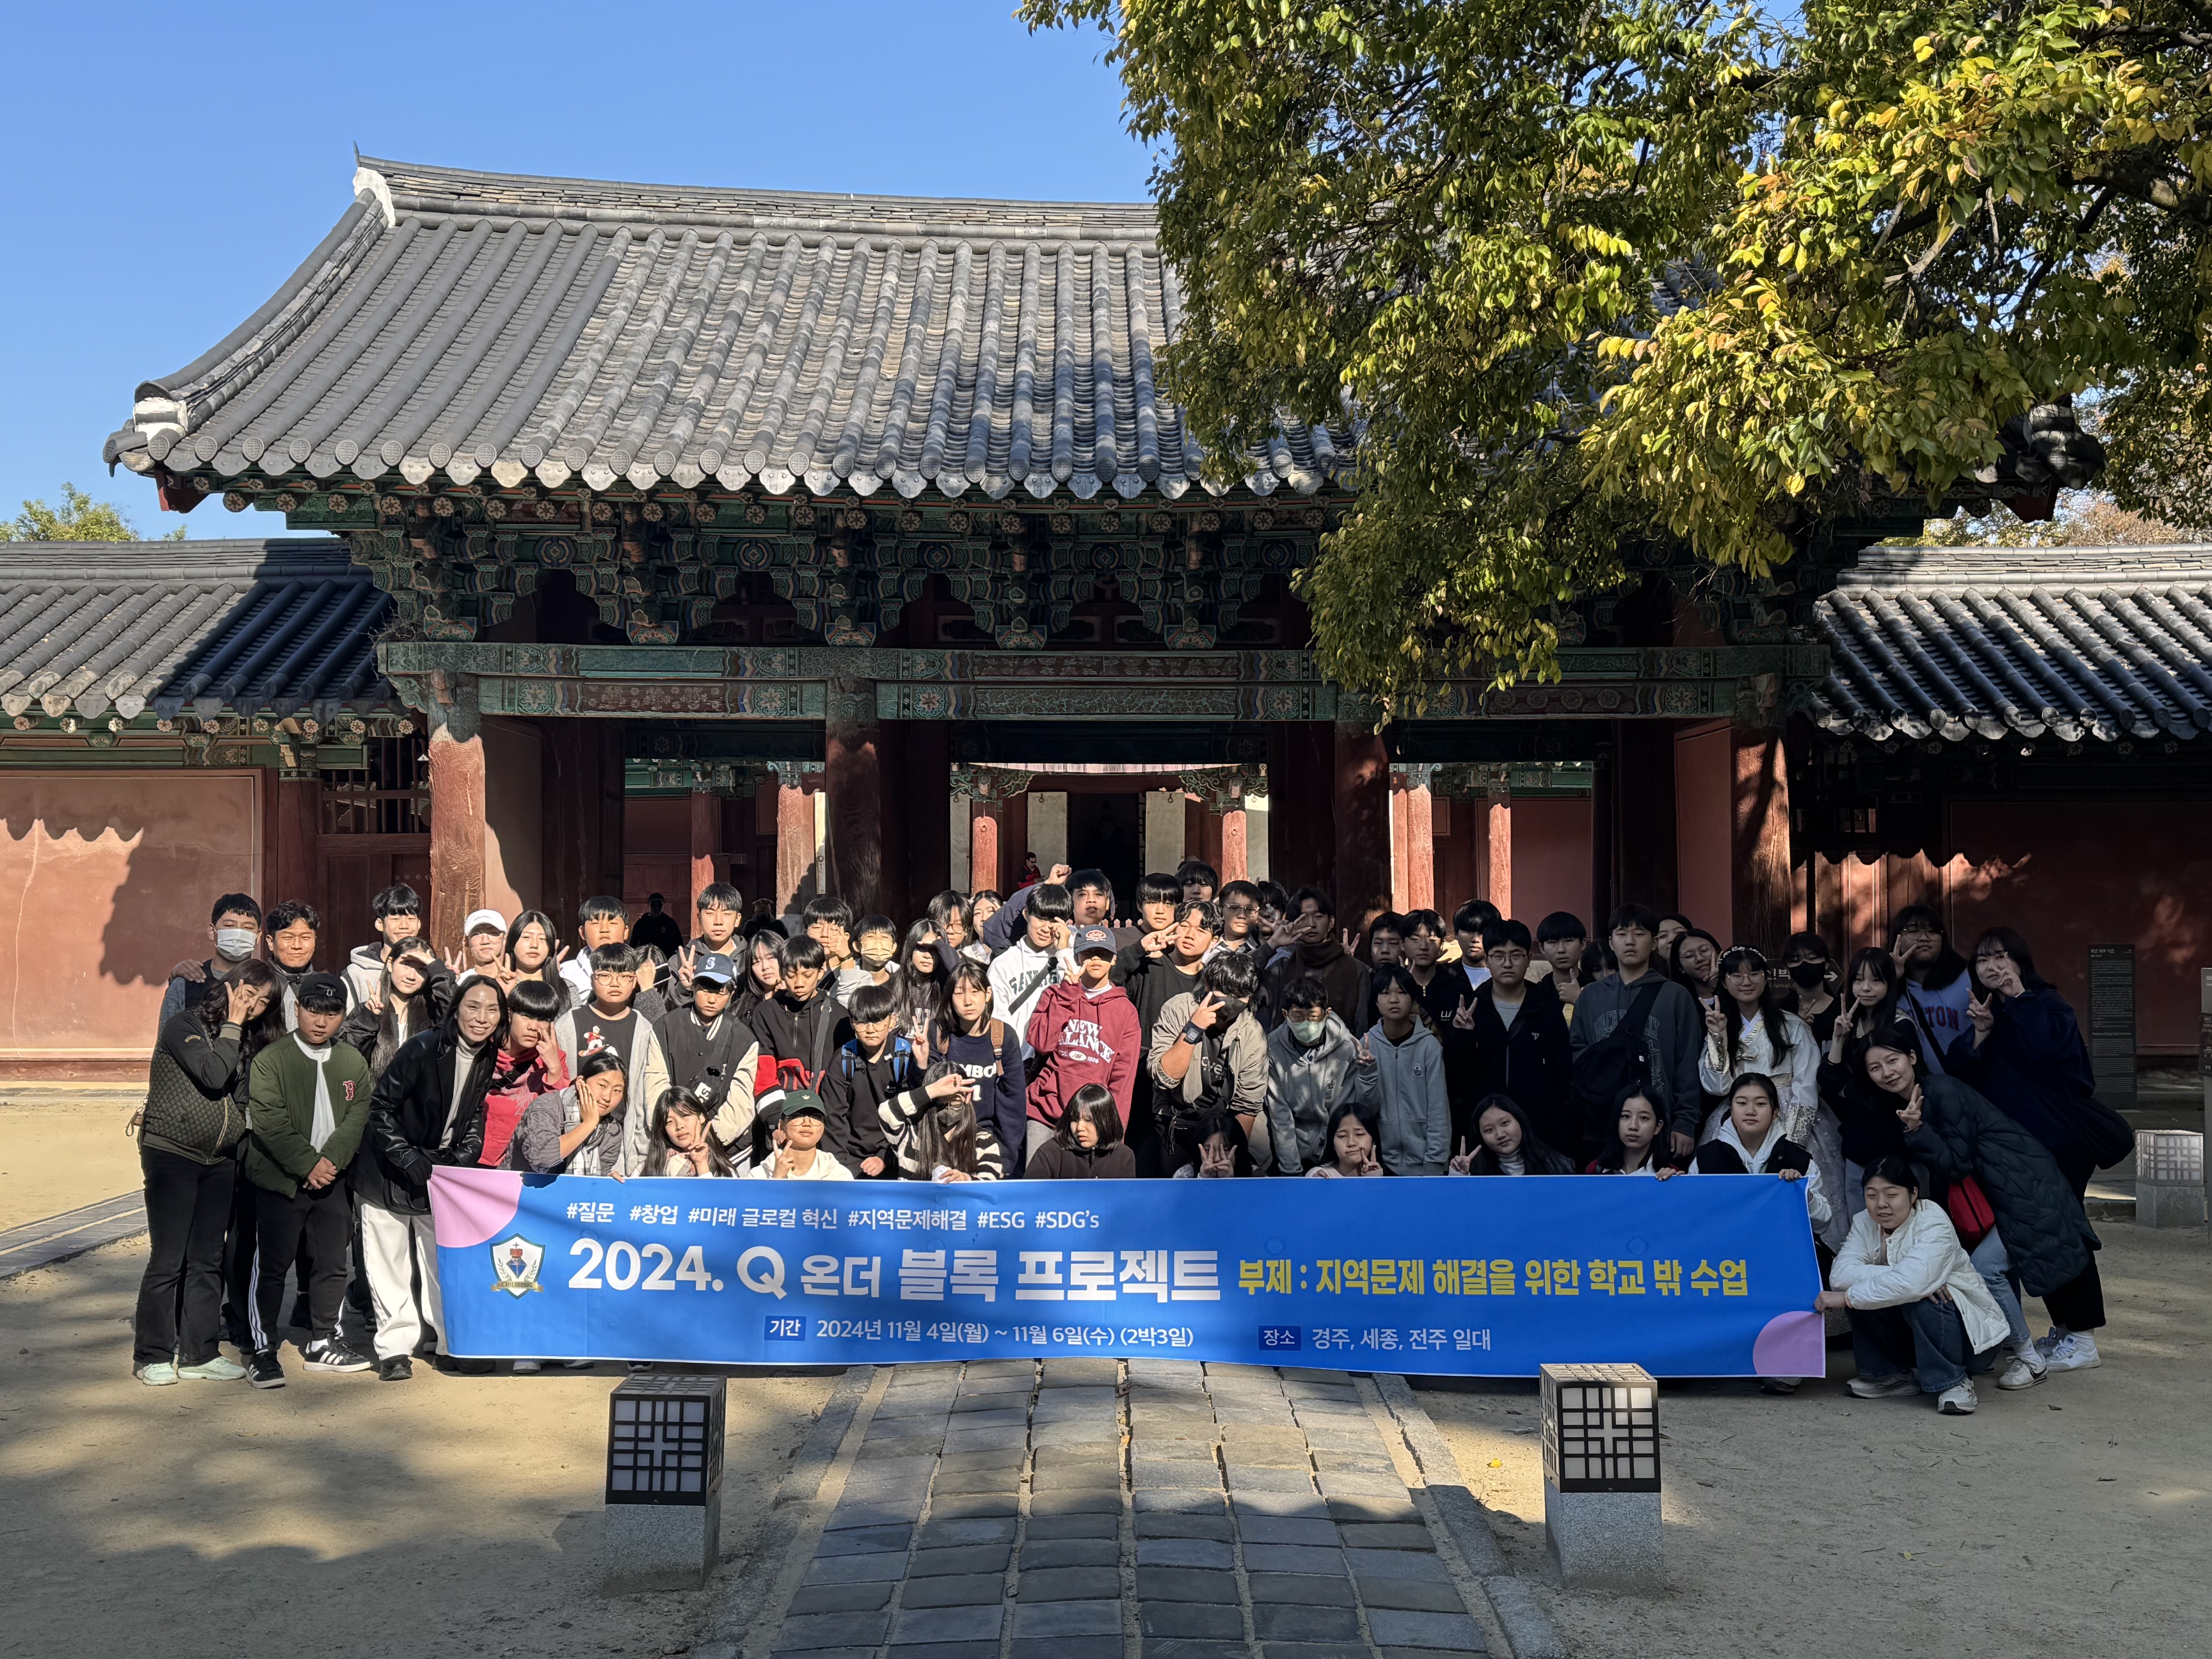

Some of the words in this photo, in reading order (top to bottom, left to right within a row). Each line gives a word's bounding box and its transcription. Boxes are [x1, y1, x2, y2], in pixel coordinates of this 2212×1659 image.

[704, 957, 716, 970] S
[1063, 1019, 1103, 1038] NEW
[1058, 1032, 1114, 1063] ALANCE
[342, 1080, 356, 1101] B
[567, 1202, 615, 1223] #질문
[630, 1204, 678, 1224] #창업
[688, 1207, 737, 1226] #미래
[742, 1208, 796, 1228] 글로컬
[802, 1208, 837, 1229] 혁신
[848, 1209, 967, 1230] #지역문제해결
[977, 1211, 1025, 1228] #ESG
[1035, 1210, 1099, 1228] #SDG's
[568, 1238, 723, 1291] 2024.
[737, 1246, 787, 1300] Q
[800, 1255, 881, 1298] 온더
[898, 1249, 998, 1302] 블록
[1015, 1250, 1220, 1303] 프로젝트
[1238, 1259, 1291, 1295] 부제
[1316, 1259, 1425, 1295] 지역문제
[1432, 1259, 1516, 1295] 해결을
[1525, 1259, 1581, 1295] 위한
[1588, 1259, 1645, 1296] 학교
[1654, 1259, 1682, 1296] 밖
[1691, 1259, 1748, 1297] 수업
[770, 1319, 801, 1336] 기간
[816, 1319, 881, 1340] 2024년
[887, 1321, 921, 1341] 11월
[926, 1322, 989, 1343] 4일(월)
[1013, 1326, 1047, 1345] 11월
[1053, 1327, 1115, 1346] 6일(수)
[1120, 1327, 1194, 1347] (2박3일)
[1264, 1329, 1295, 1346] 장소
[1312, 1328, 1355, 1350] 경주,
[1360, 1328, 1403, 1350] 세종,
[1409, 1328, 1448, 1350] 전주
[1453, 1329, 1491, 1351] 일대
